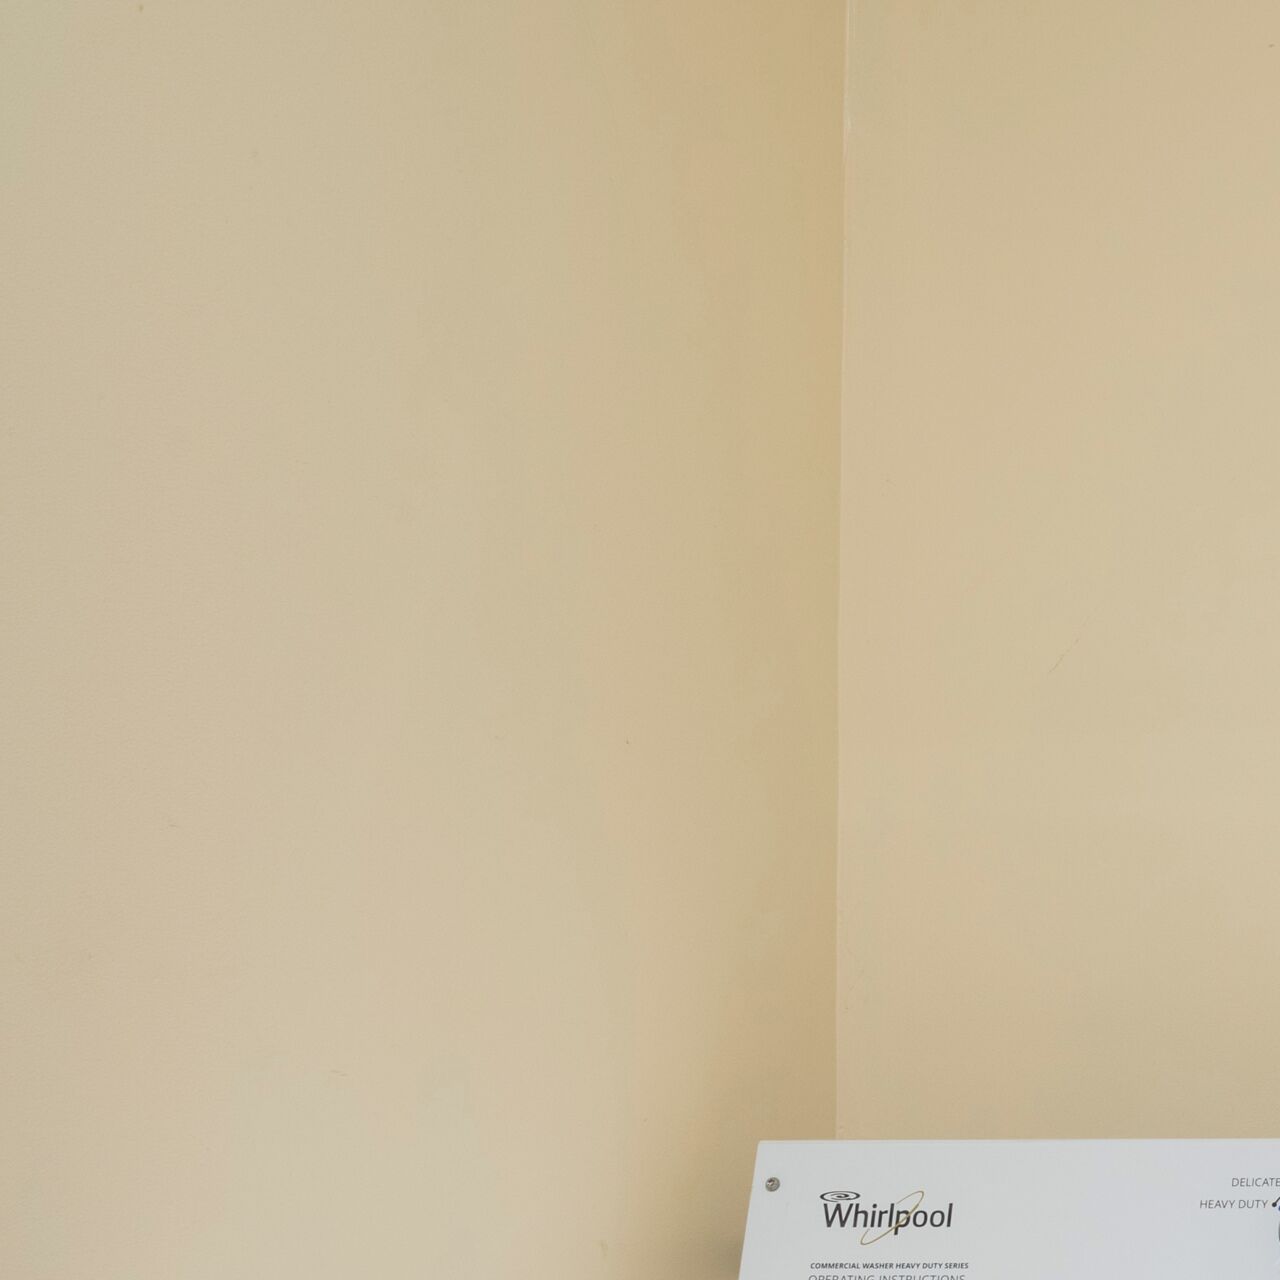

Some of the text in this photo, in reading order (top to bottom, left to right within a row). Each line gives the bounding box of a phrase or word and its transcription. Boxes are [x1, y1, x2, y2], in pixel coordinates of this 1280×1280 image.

[1200, 1200, 1269, 1209] HEAVY DUTY
[824, 1203, 953, 1235] Whirlpool
